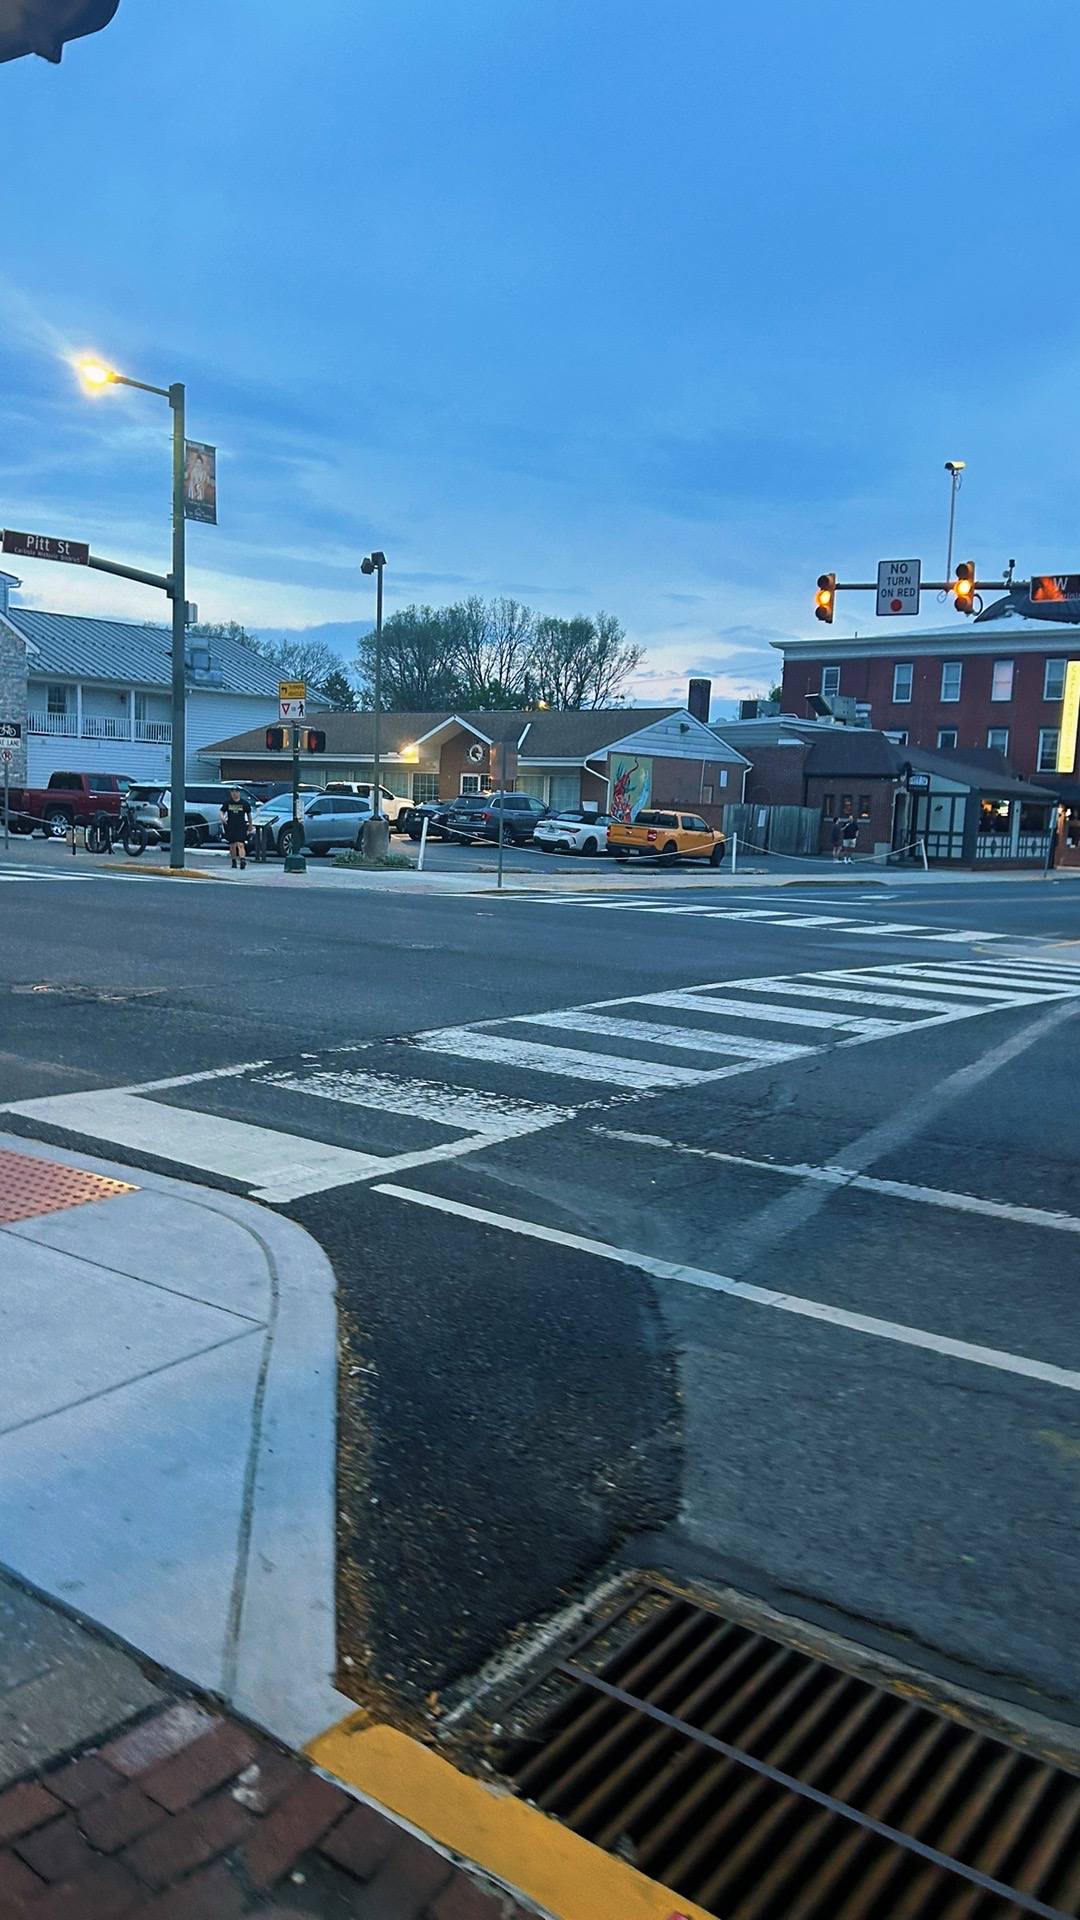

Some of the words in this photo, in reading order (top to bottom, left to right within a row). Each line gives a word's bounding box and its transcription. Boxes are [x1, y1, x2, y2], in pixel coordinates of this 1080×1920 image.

[27, 536, 50, 551] Pitt
[57, 541, 70, 555] St
[890, 563, 908, 574] NO
[887, 576, 911, 586] TURN
[1053, 577, 1068, 590] W
[881, 589, 894, 598] ON
[897, 588, 916, 597] RED
